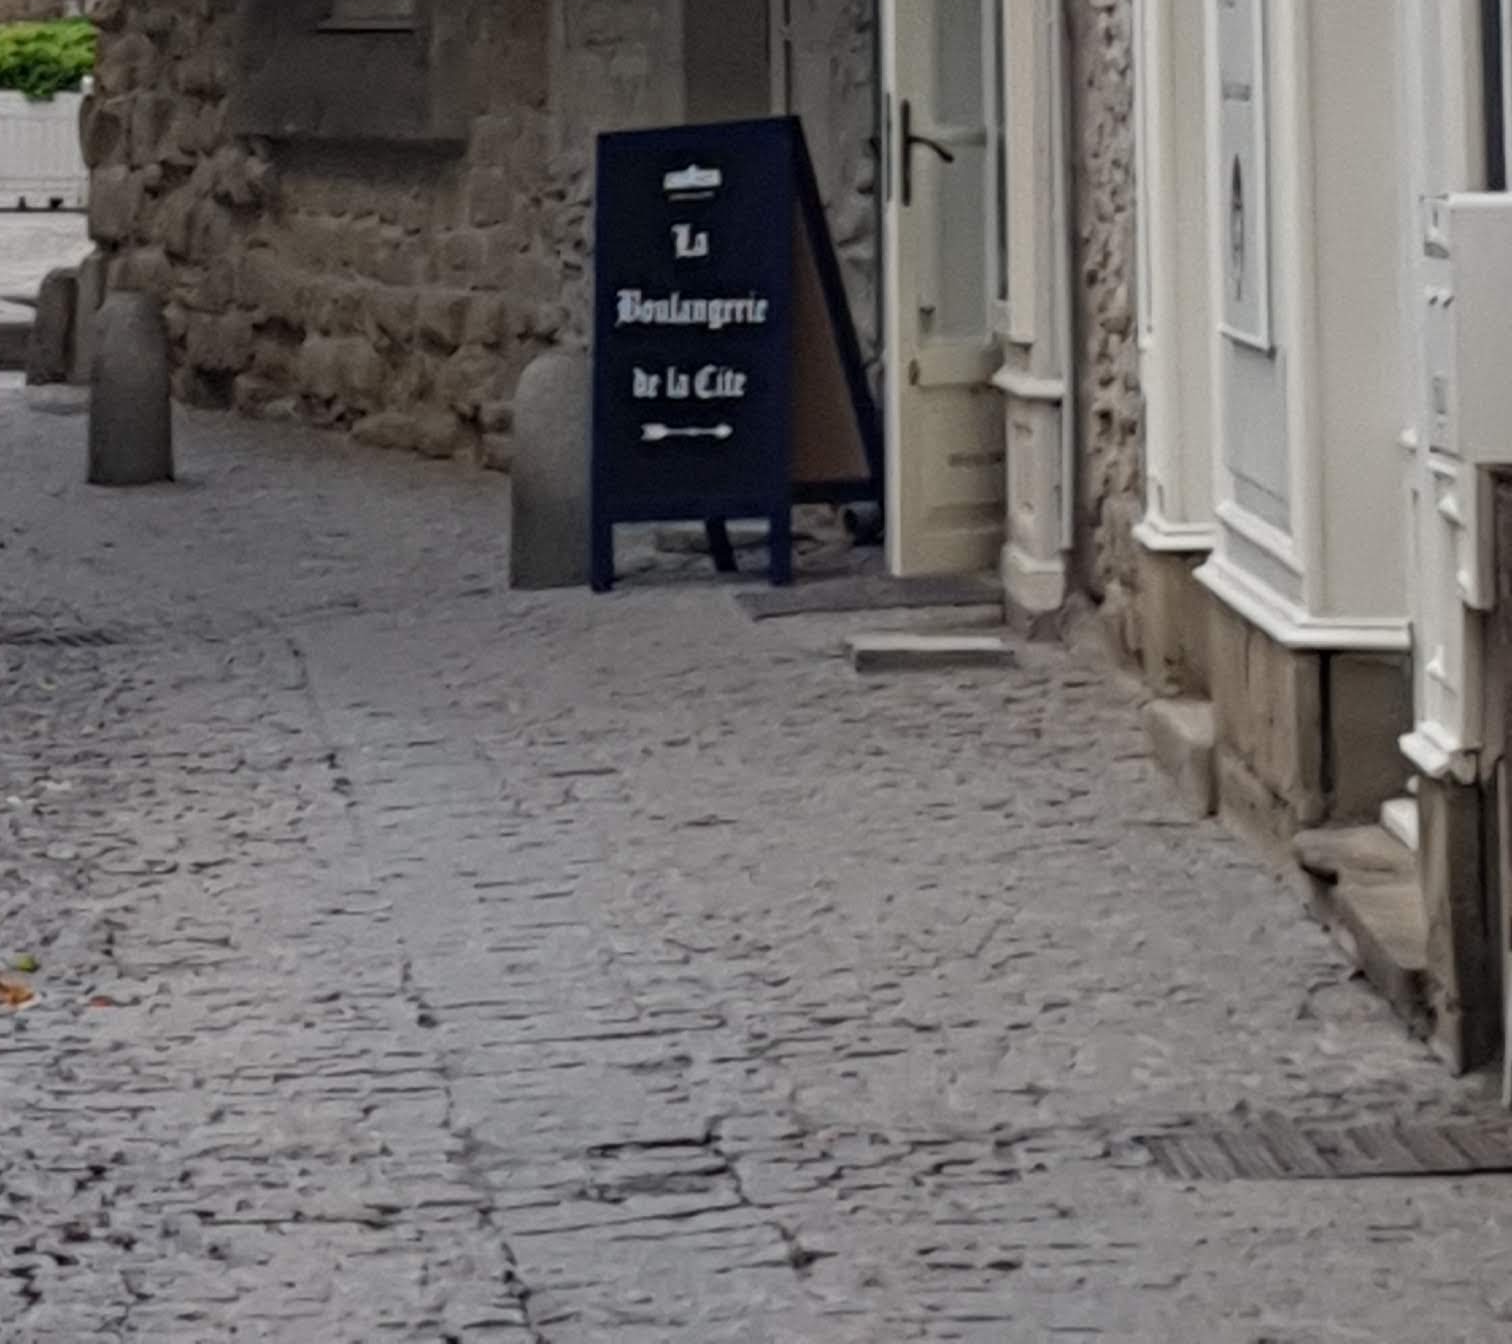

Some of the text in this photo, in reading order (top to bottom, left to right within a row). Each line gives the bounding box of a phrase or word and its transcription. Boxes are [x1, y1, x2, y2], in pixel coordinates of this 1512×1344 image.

[670, 223, 709, 258] La
[614, 288, 769, 330] Boulangerie
[632, 366, 662, 399] de
[666, 366, 690, 399] la
